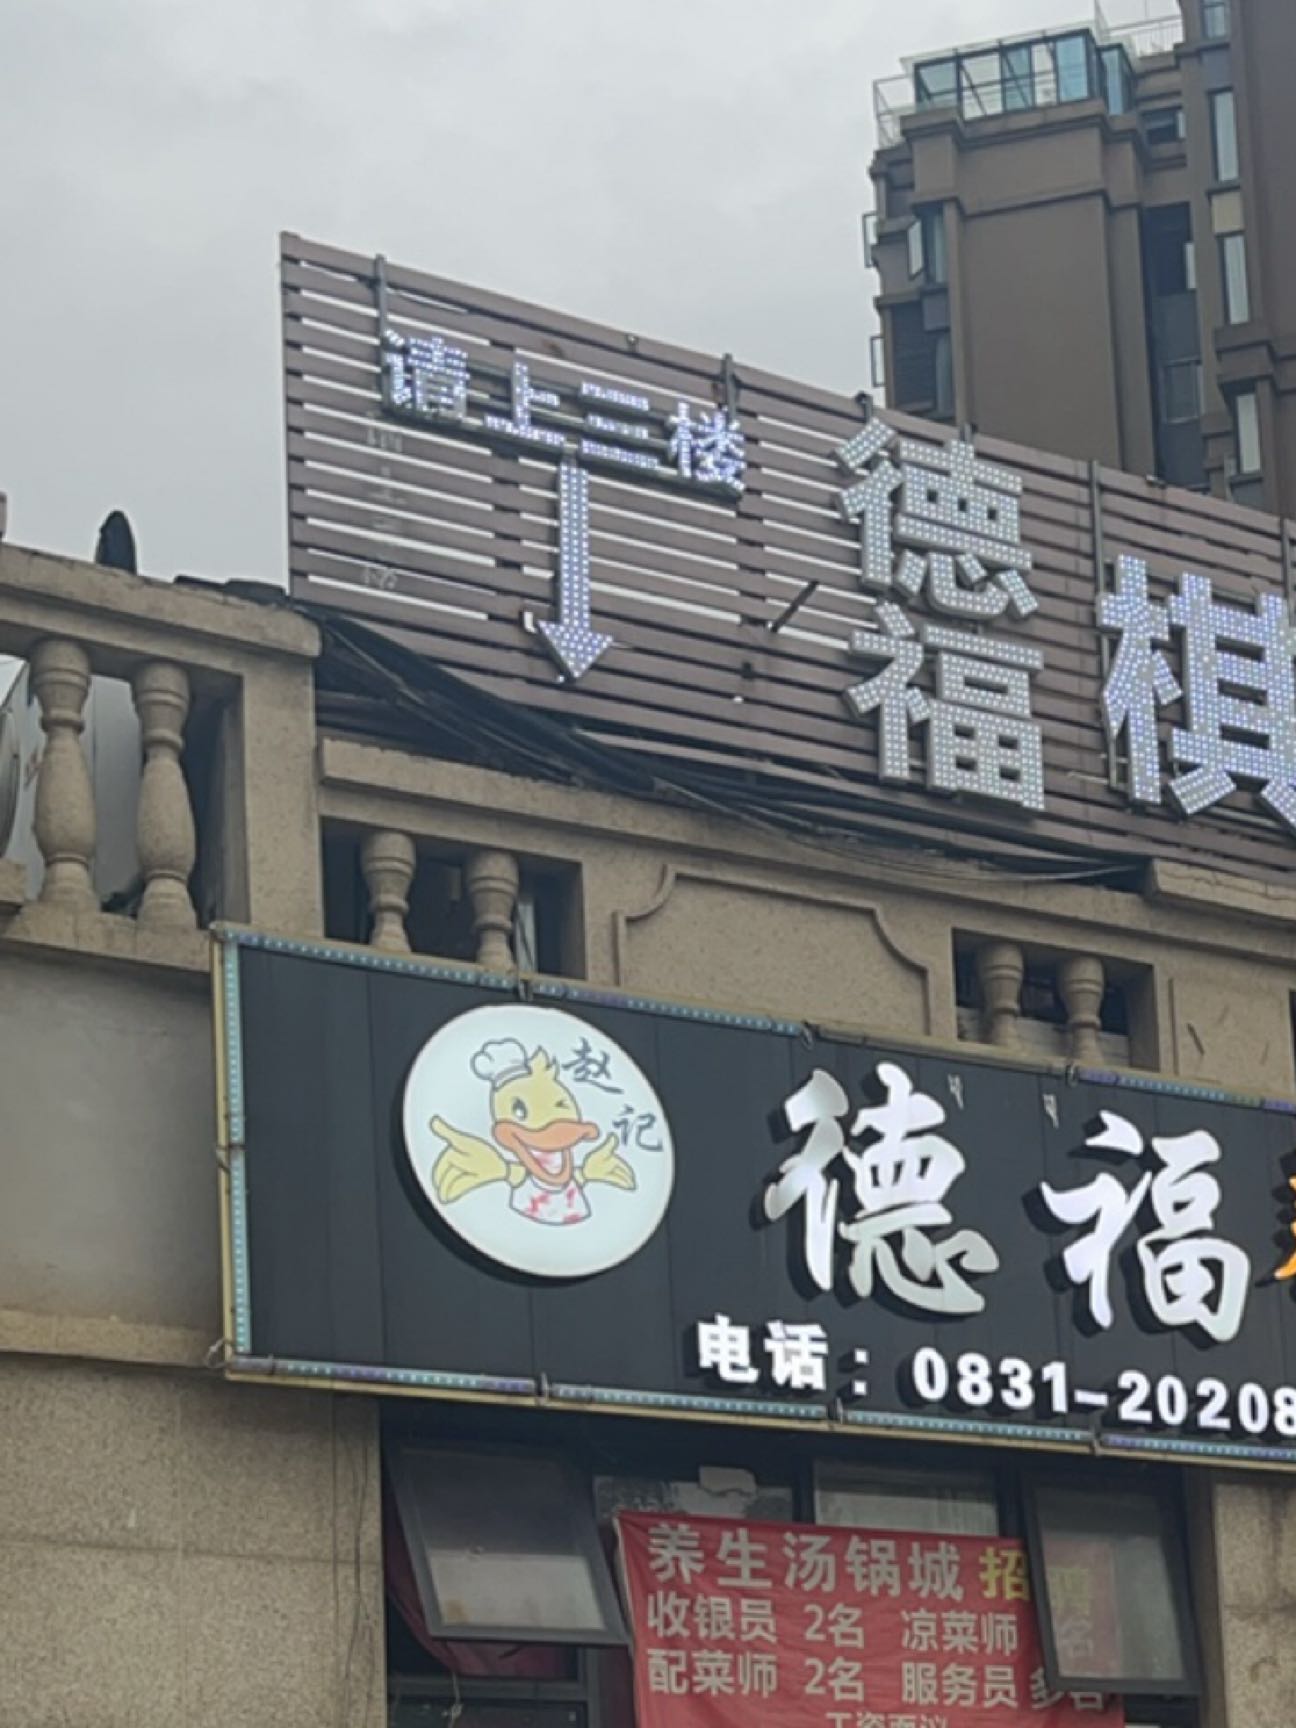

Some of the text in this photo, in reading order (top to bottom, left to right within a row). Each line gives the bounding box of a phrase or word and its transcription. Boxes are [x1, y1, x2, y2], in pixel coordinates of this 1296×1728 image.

[383, 329, 747, 492] 请上三楼
[833, 419, 1045, 810] 德福
[558, 1036, 664, 1152] 赵记
